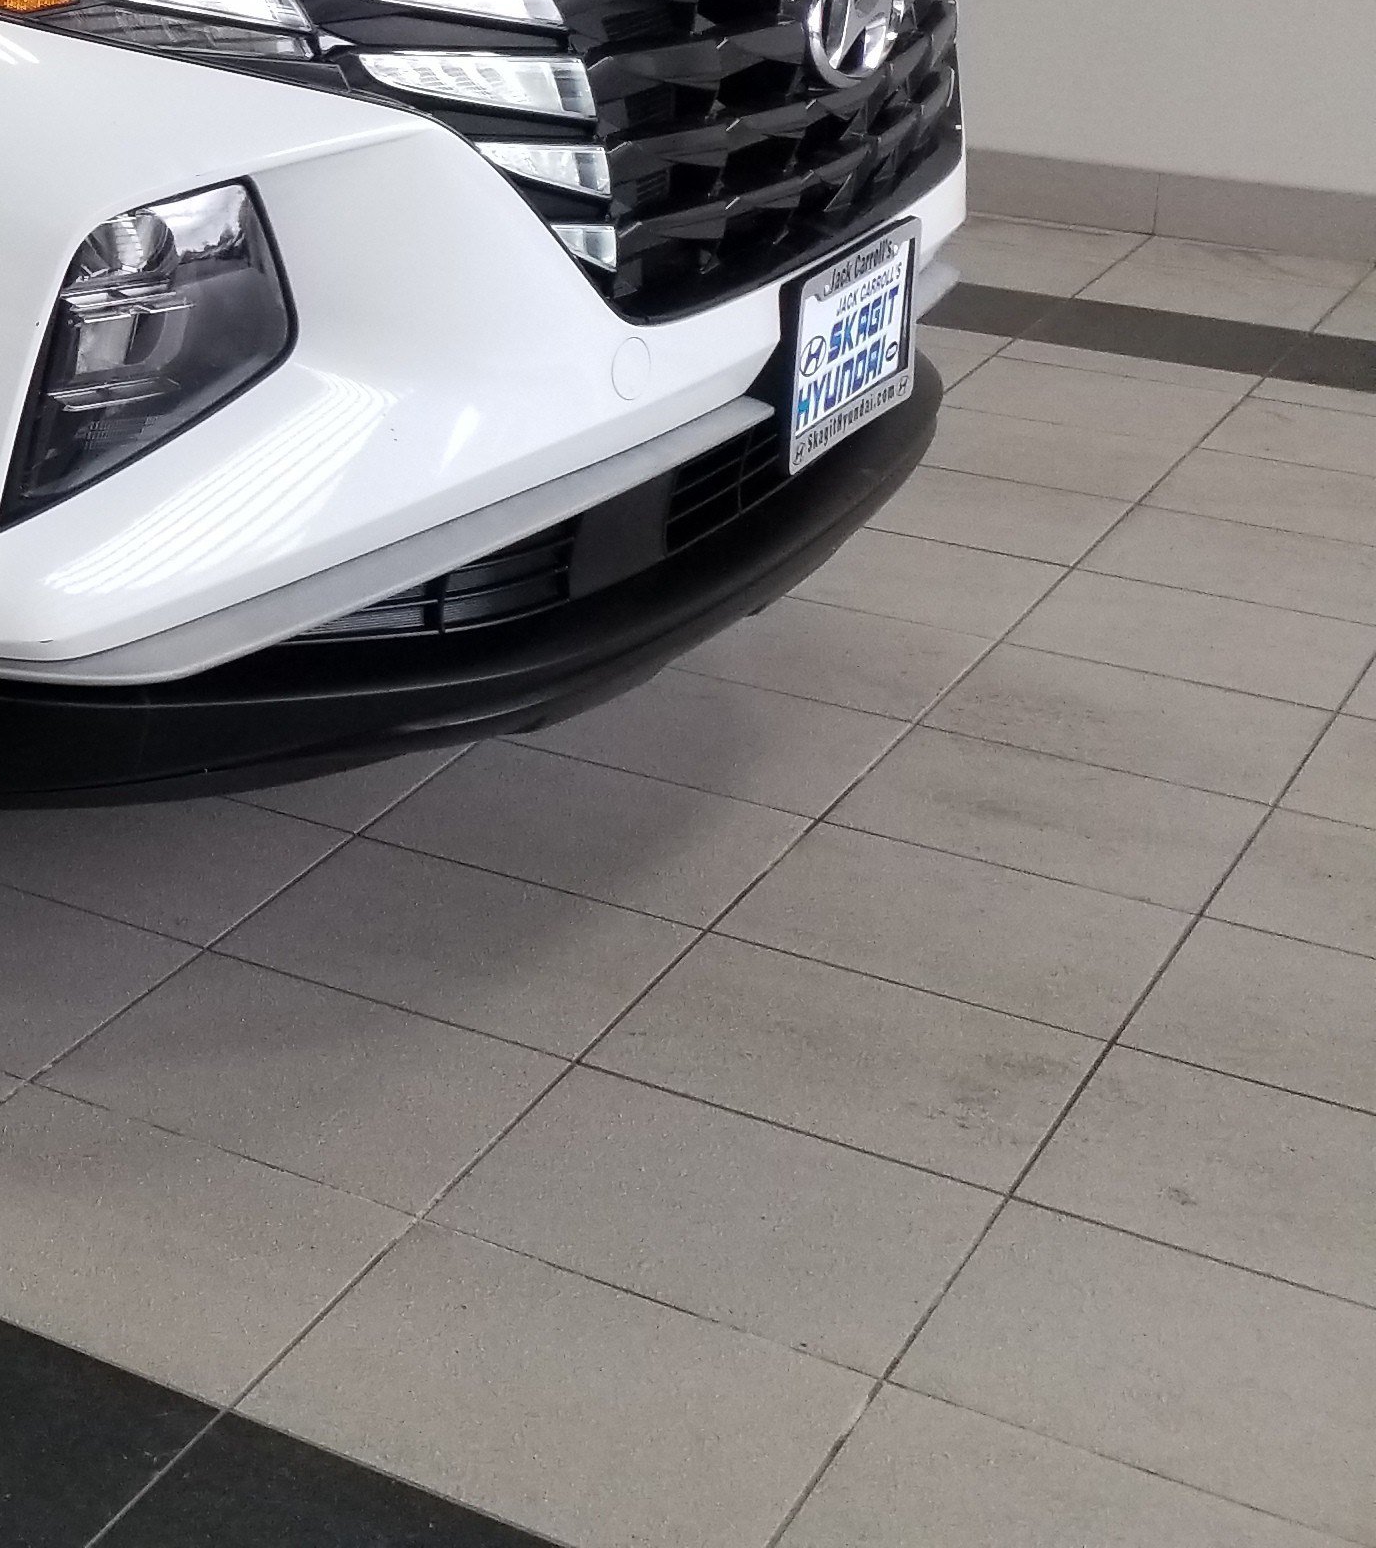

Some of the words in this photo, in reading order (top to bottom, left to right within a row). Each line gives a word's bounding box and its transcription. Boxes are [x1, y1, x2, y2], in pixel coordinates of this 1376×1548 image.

[824, 260, 852, 297] Jack
[854, 237, 895, 279] Carroll's
[836, 288, 859, 317] JACK
[860, 261, 903, 303] CARROLL'S
[827, 284, 900, 364] SKAGIT
[795, 334, 886, 432] HYUNDAI
[807, 384, 896, 453] SkagitHyundai.com
